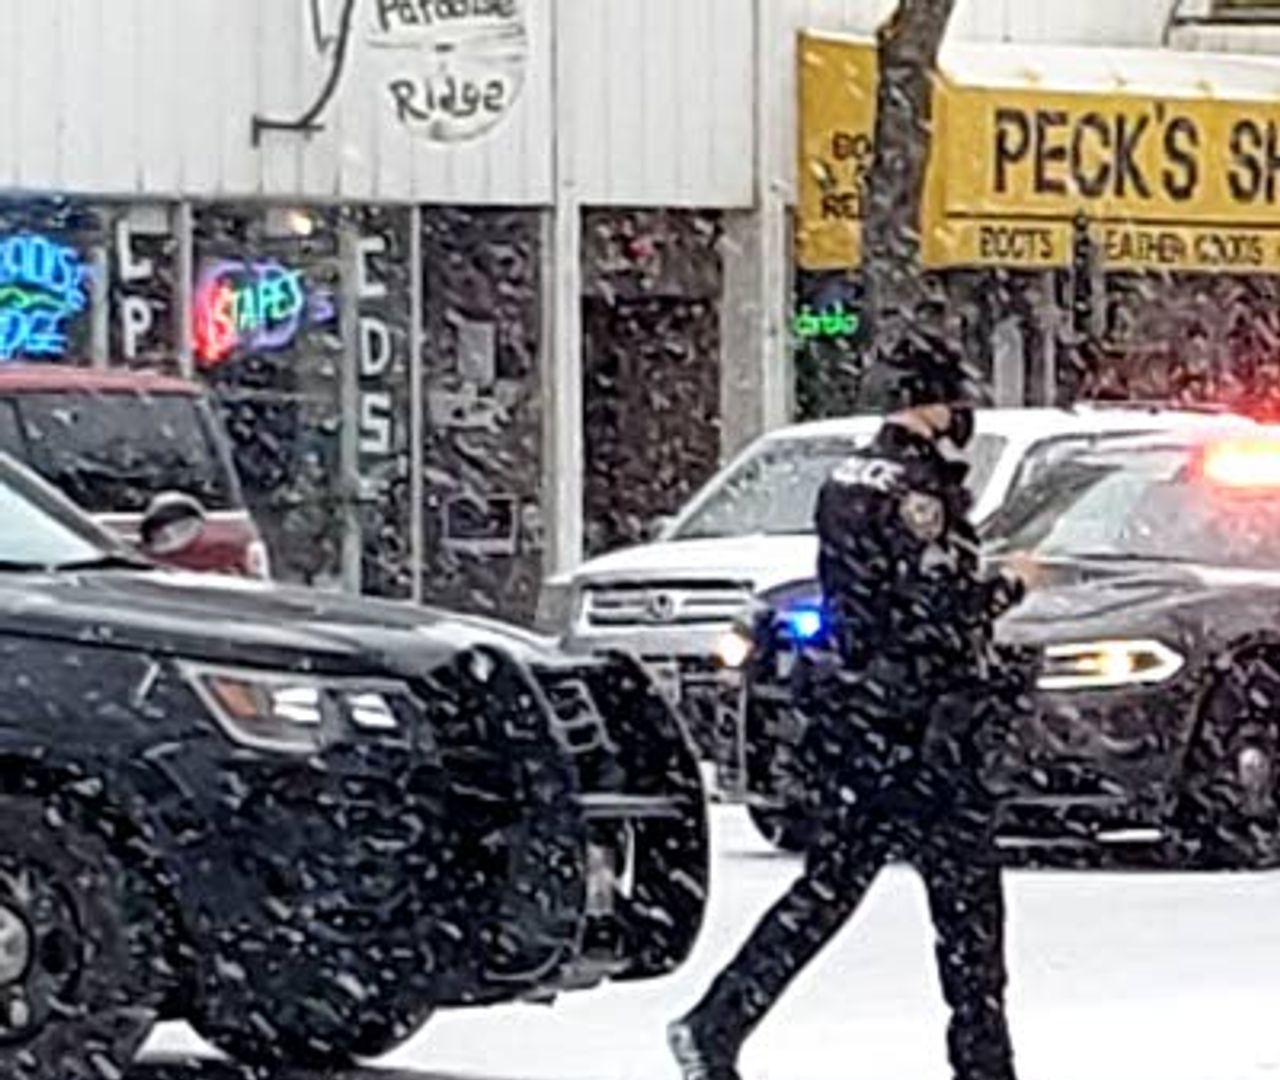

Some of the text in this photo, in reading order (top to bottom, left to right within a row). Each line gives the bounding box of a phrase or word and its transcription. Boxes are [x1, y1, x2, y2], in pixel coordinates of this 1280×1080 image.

[388, 75, 504, 123] Ridge
[994, 102, 1199, 200] PECK'S
[979, 225, 1054, 259] BOOTS
[1103, 230, 1188, 263] EATHER
